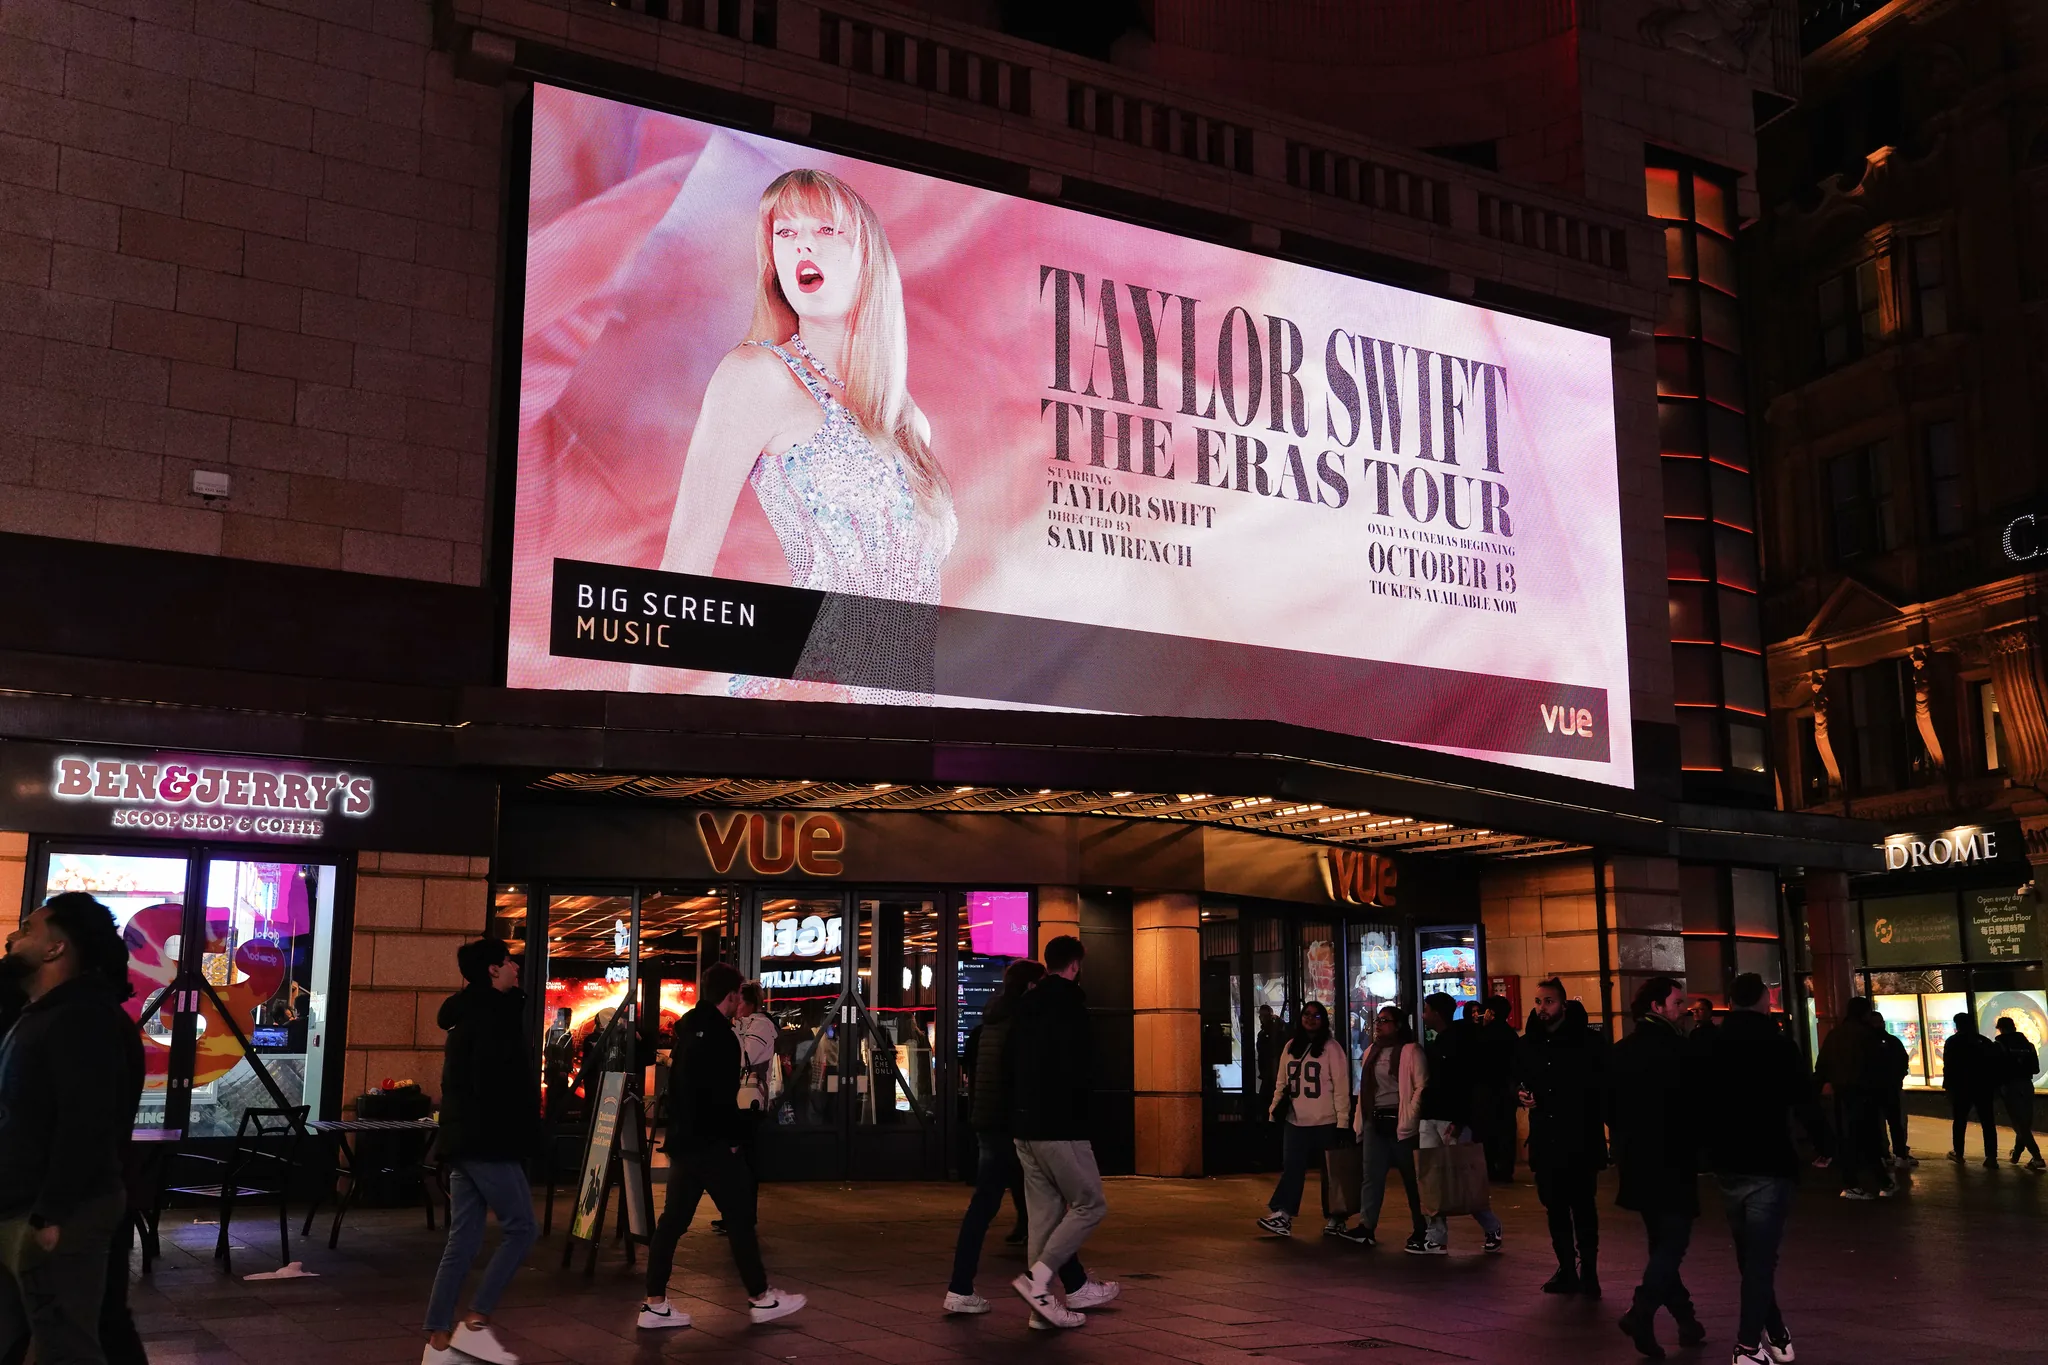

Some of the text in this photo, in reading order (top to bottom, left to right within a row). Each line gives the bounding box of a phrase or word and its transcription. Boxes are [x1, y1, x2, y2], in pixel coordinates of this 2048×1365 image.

[1040, 264, 1509, 475] TAYLOR SWIFT
[1041, 398, 1515, 538] THE ERAS TOUR
[1047, 466, 1112, 486] STARRING
[1047, 480, 1217, 529] TAYLOR SWIFT
[1048, 509, 1133, 532] DIRECTED BY
[1047, 525, 1192, 568] SAM WRENCH
[1367, 523, 1516, 557] ONLY IN CINEMAS BEGINNING
[2003, 513, 2048, 561] C
[1368, 541, 1517, 595] OCTOBER 13
[578, 584, 756, 628] BIG SCREEN
[1369, 580, 1518, 615] TICKETS AVAILABLE NOW
[576, 616, 671, 649] MUSIC
[114, 809, 324, 837] SCOOP SHOP & COFFEE
[1976, 893, 2024, 906] Open every day
[1984, 905, 1999, 914] 6pm
[1973, 913, 2032, 925] Lower Ground Floor
[1987, 937, 2001, 946] 6pm
[2007, 935, 2021, 944] 4am
[1287, 1061, 1322, 1098] 89
